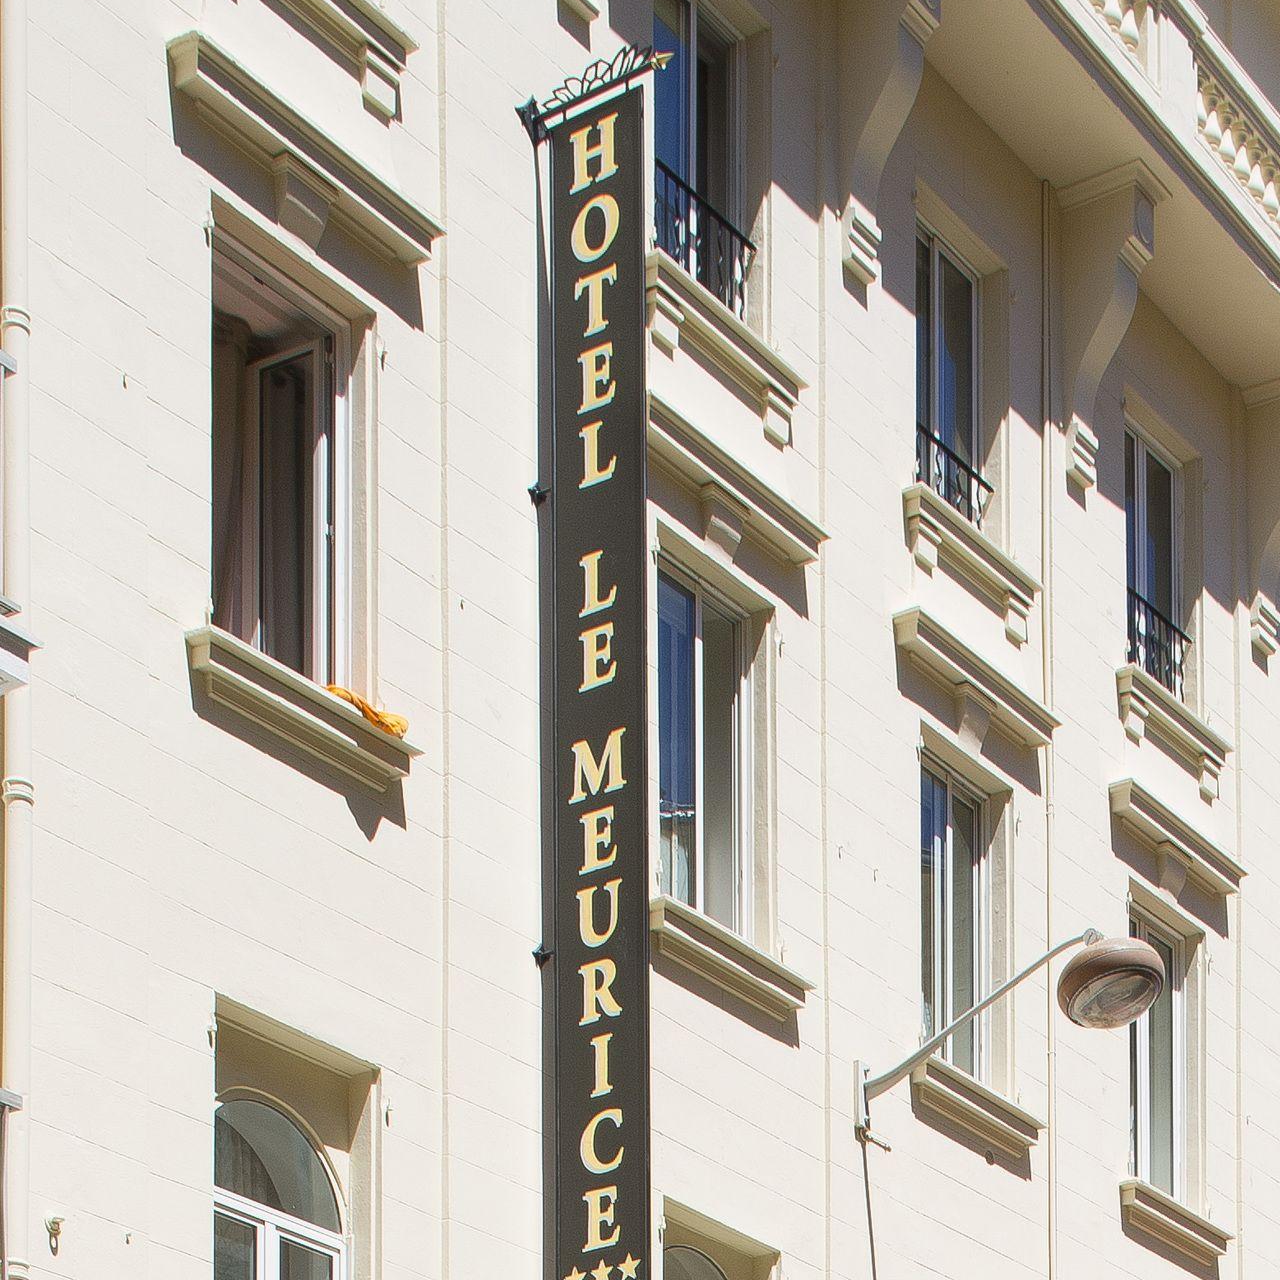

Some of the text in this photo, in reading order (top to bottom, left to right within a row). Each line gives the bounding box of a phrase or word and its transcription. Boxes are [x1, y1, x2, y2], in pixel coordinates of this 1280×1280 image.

[568, 111, 628, 1253] HOTEL LE MEURICE
